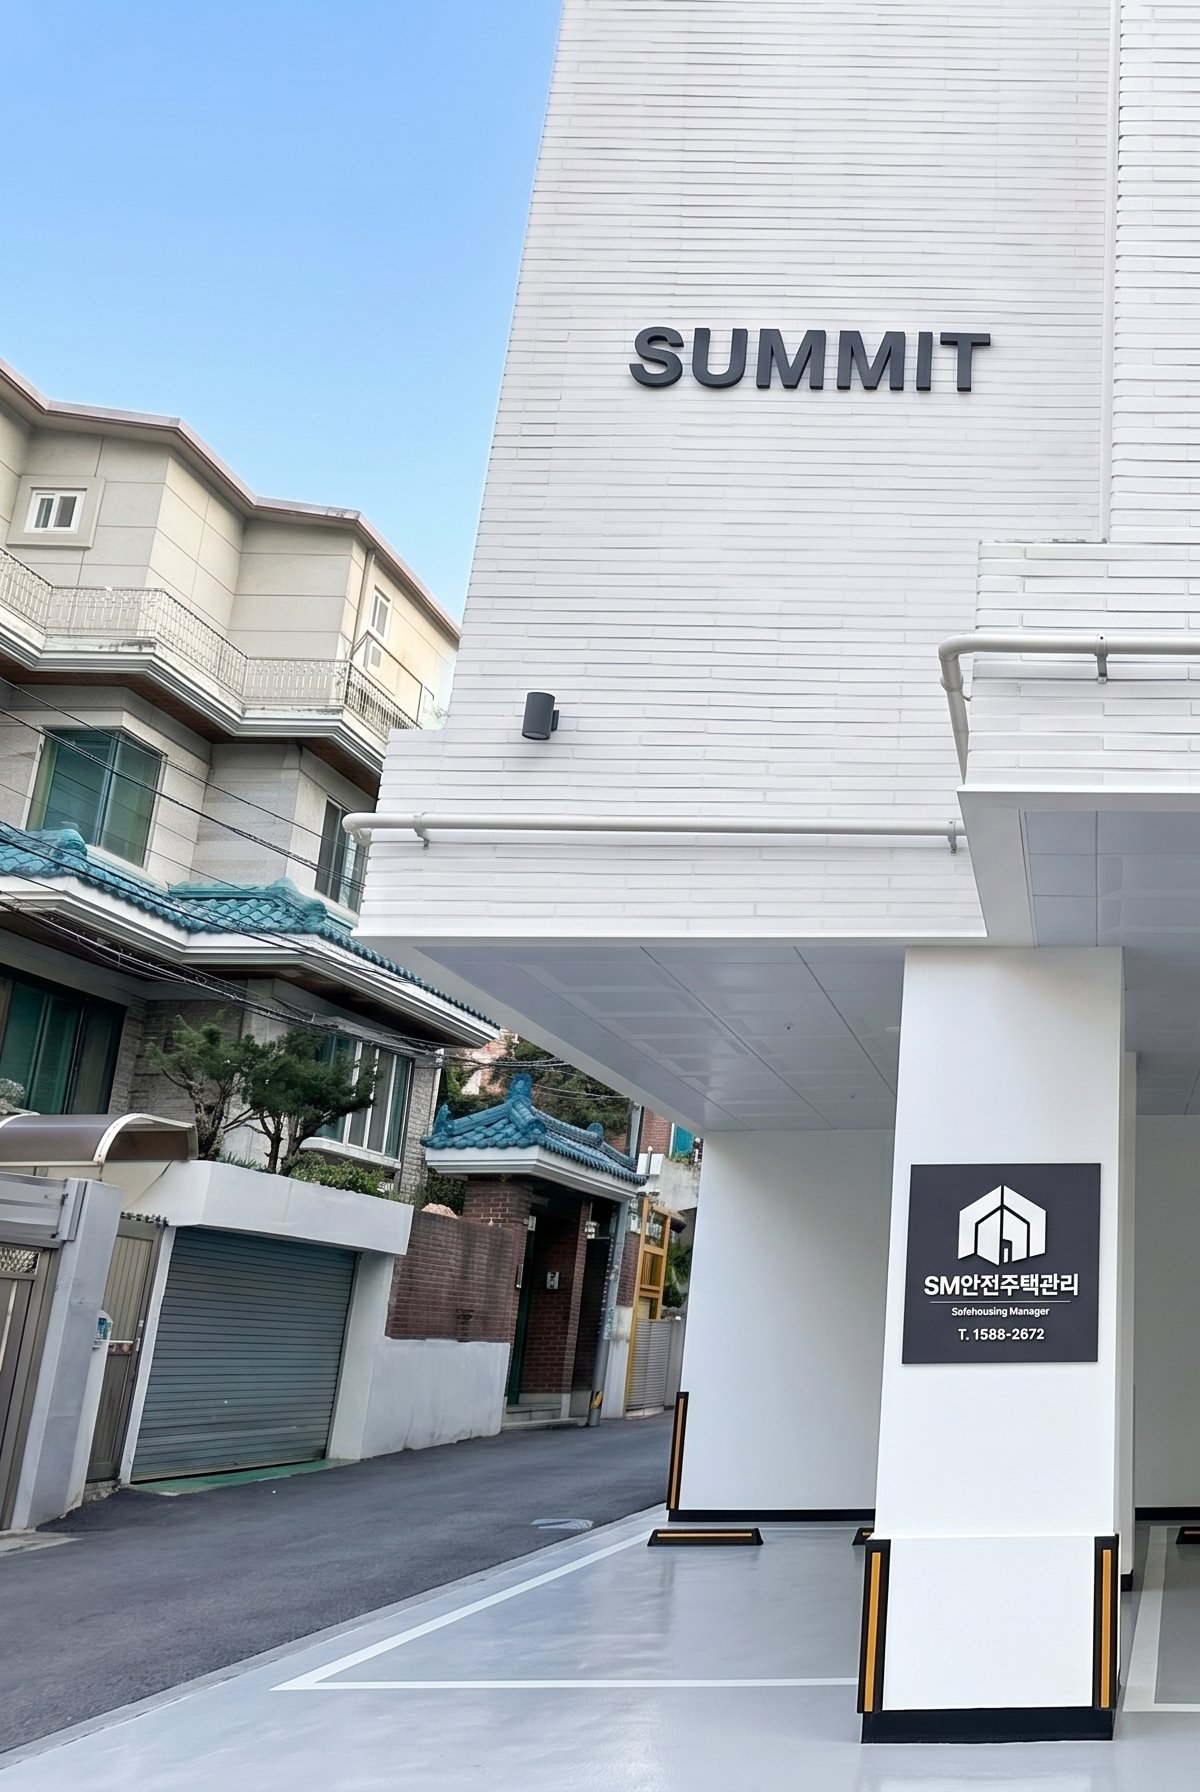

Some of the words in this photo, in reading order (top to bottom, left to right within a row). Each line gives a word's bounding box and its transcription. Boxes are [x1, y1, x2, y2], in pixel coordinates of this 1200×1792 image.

[629, 326, 991, 392] SUMMIT
[924, 1273, 1079, 1296] SM안전주택관리
[1009, 1307, 1050, 1318] Manager
[958, 1328, 970, 1341] T.
[973, 1328, 1045, 1341] 1588-2672
